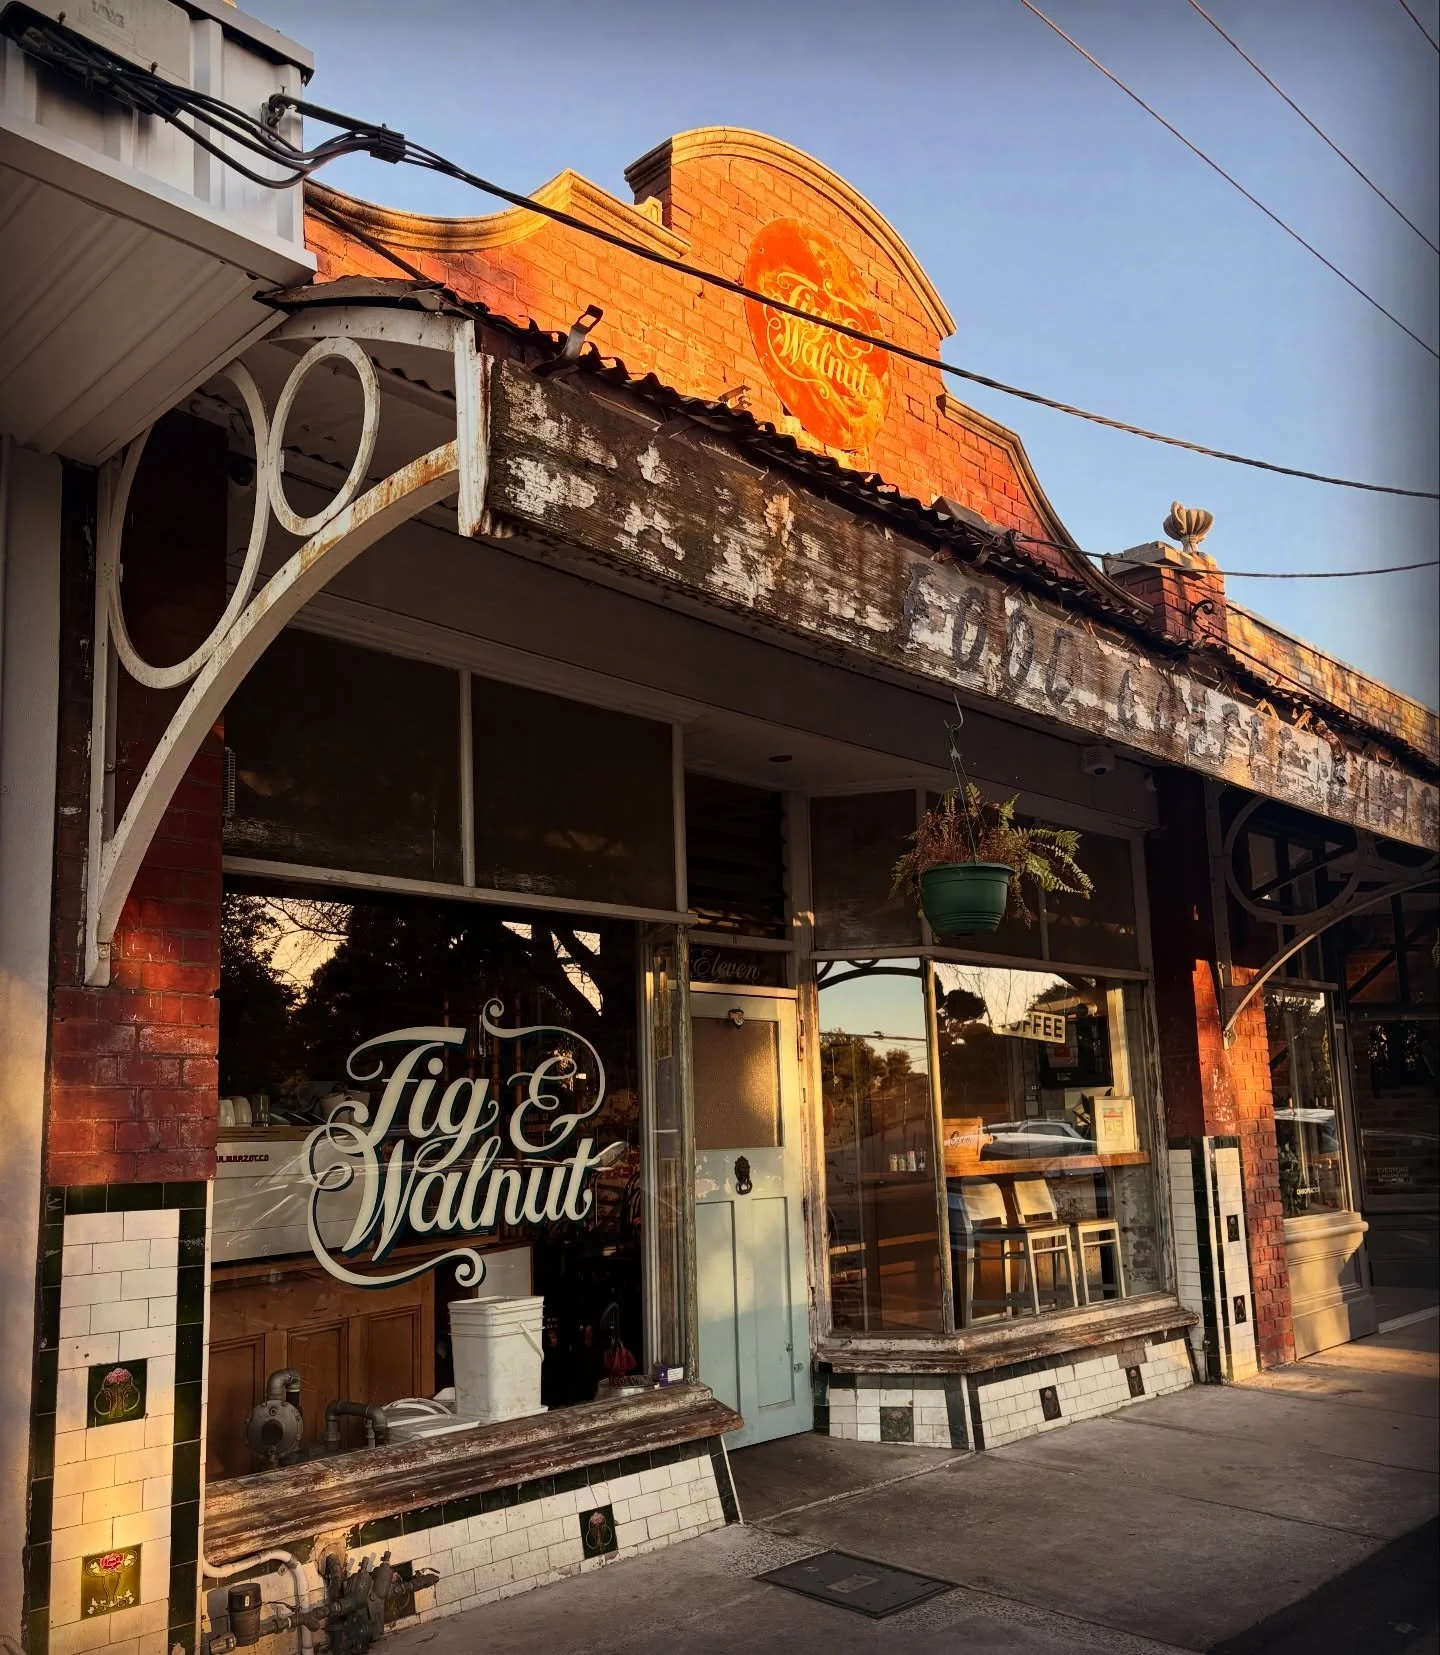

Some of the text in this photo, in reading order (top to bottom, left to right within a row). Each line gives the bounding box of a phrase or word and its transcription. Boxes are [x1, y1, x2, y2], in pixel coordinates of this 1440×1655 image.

[763, 292, 881, 400] Walnut
[770, 271, 835, 343] Fig
[693, 949, 761, 980] Eleven
[325, 1026, 500, 1171] Fig
[225, 1154, 269, 1162] MARZOCCO
[301, 1123, 626, 1288] Walnut
